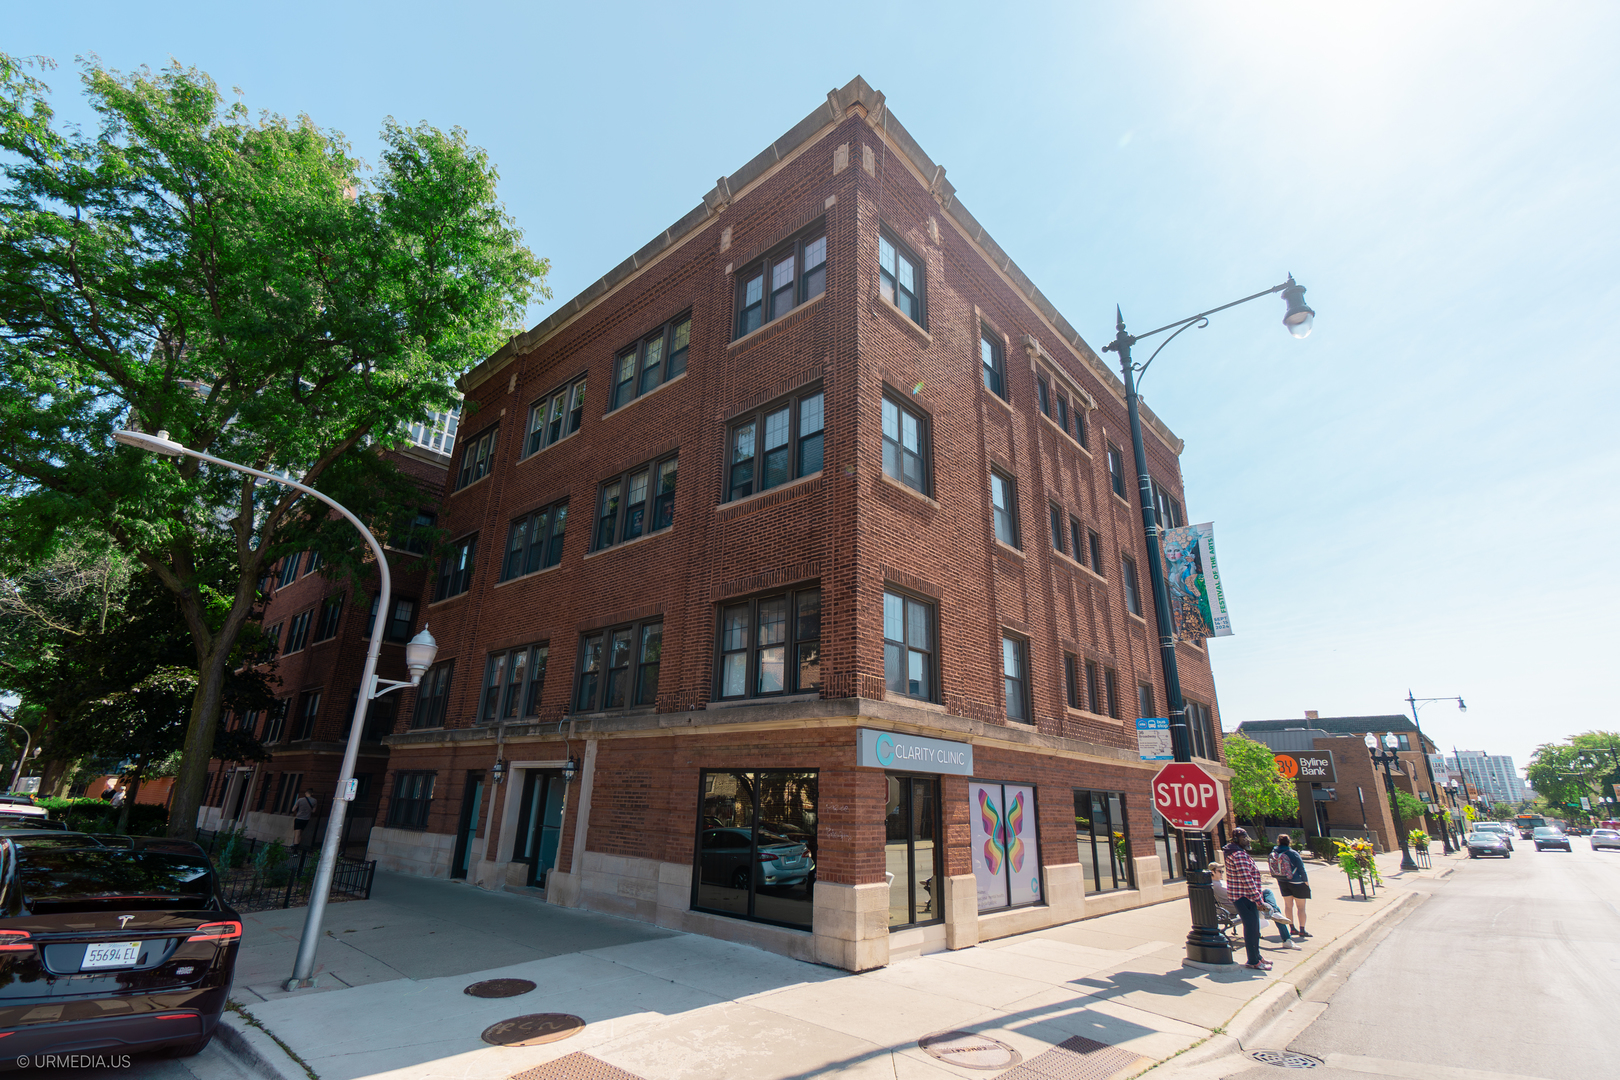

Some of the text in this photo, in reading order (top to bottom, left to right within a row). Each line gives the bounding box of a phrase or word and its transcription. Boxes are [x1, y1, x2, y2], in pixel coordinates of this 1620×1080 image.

[1212, 571, 1219, 579] OF
[1215, 580, 1226, 613] FESTIVAL
[895, 744, 934, 762] CLARITY
[937, 749, 965, 766] CLINIC
[1299, 758, 1328, 768] Byline
[1300, 766, 1326, 776] Bank
[1157, 782, 1214, 808] STOP
[89, 948, 136, 962] 55694 EL
